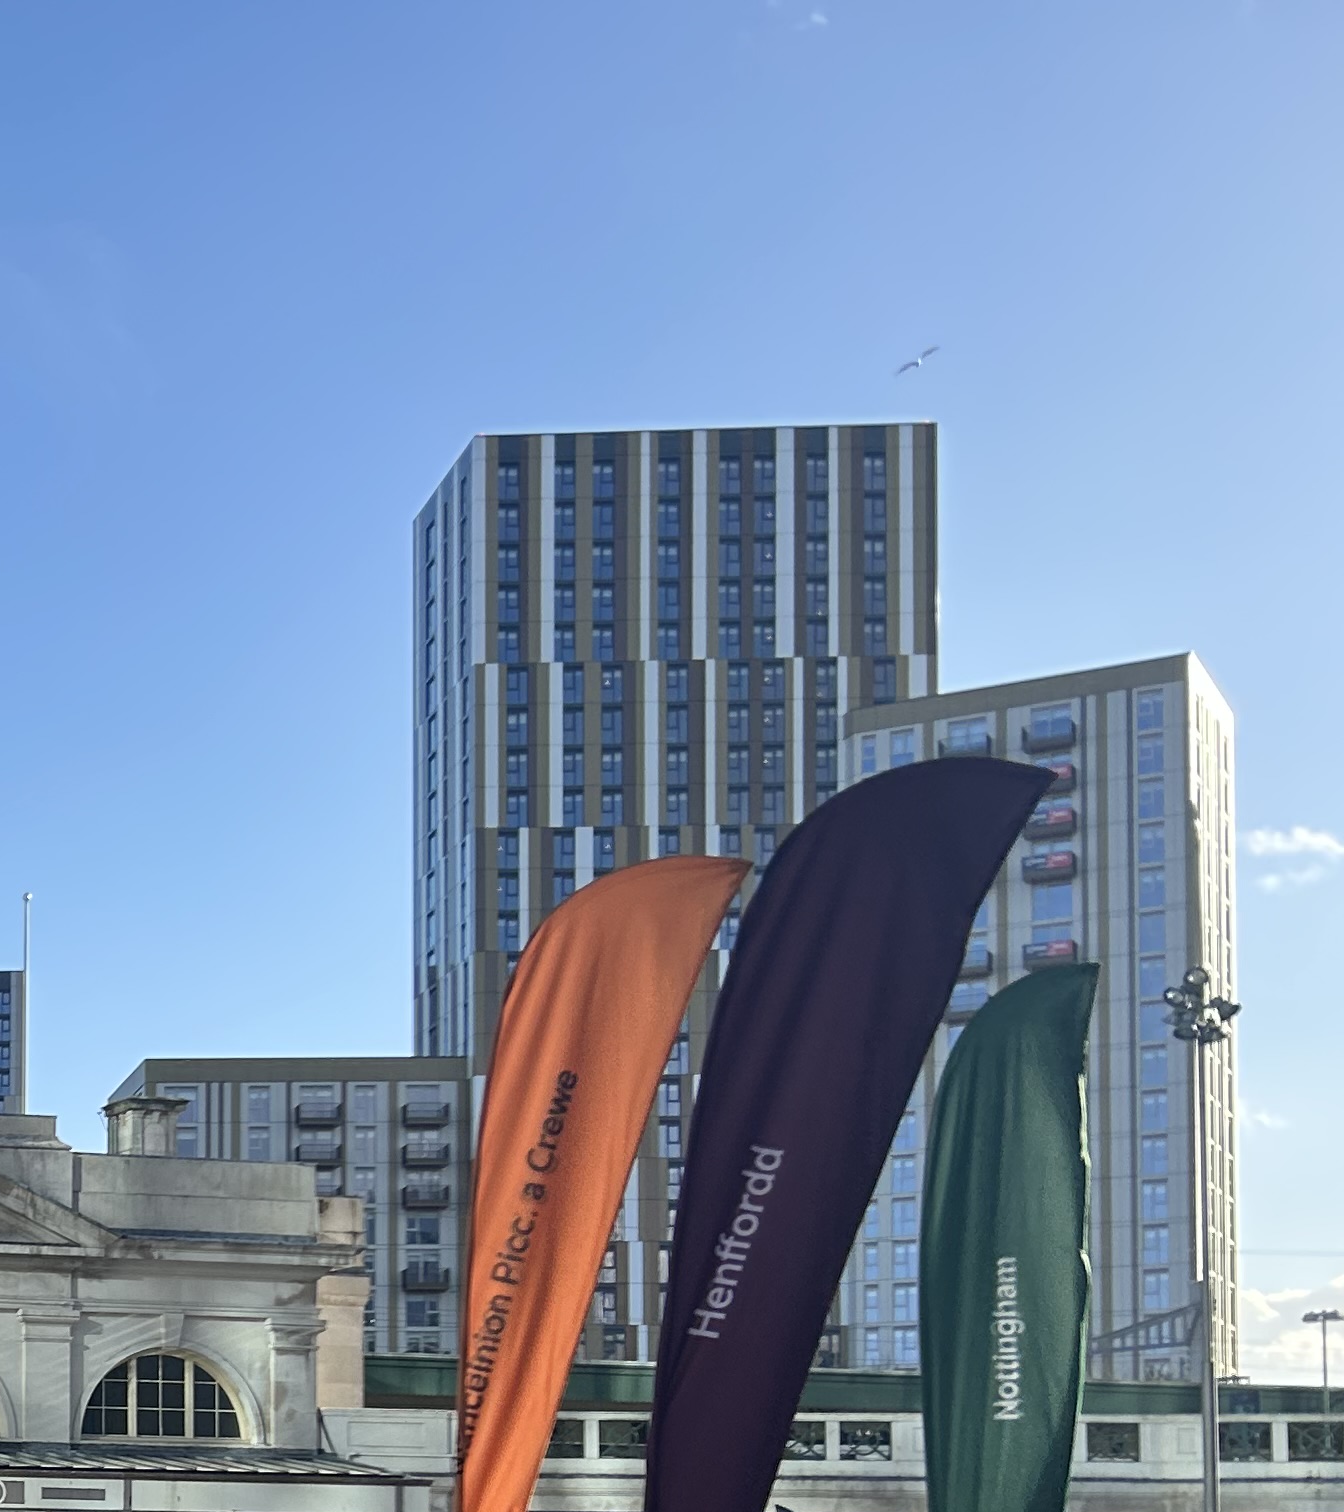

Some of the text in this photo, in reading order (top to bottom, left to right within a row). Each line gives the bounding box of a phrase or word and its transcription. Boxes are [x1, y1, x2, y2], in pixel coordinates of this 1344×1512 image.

[527, 1069, 579, 1174] Crewe
[522, 1182, 546, 1201] a
[688, 1146, 785, 1340] Henffordd
[492, 1210, 539, 1285] Picc.
[993, 1257, 1025, 1421] Nottingham
